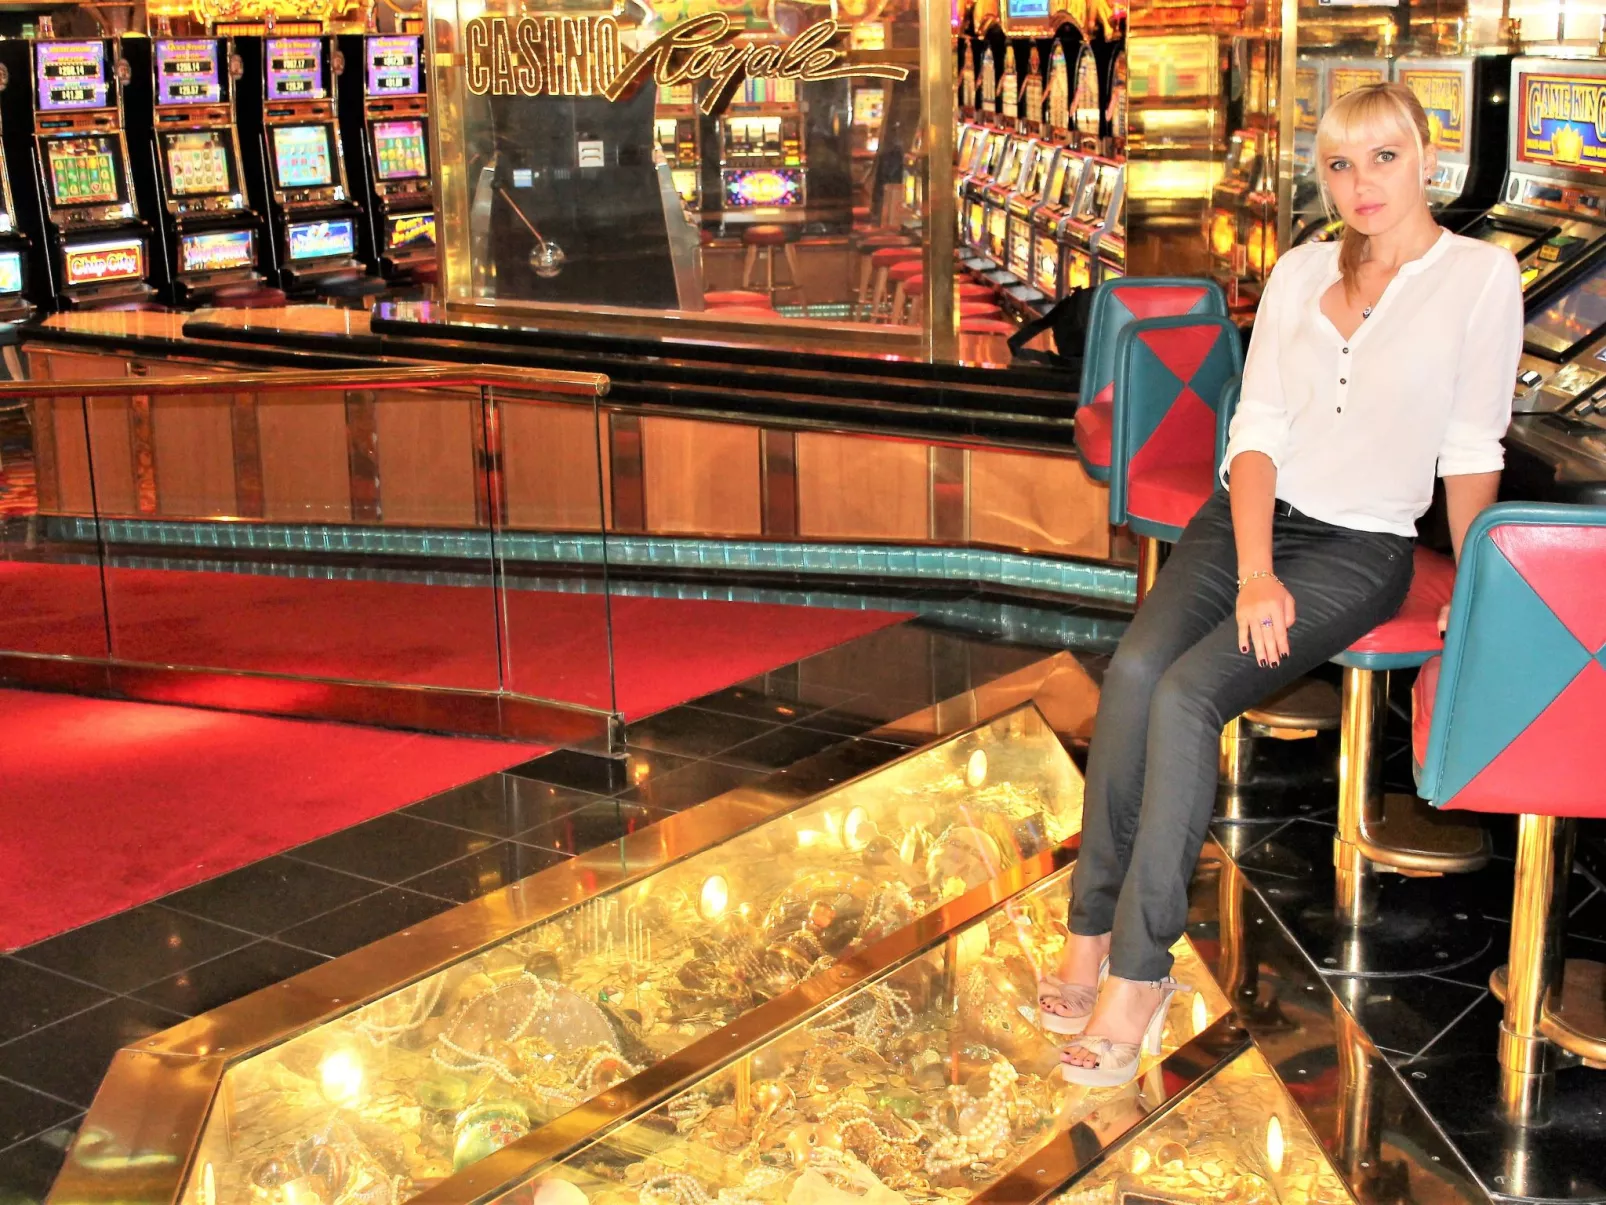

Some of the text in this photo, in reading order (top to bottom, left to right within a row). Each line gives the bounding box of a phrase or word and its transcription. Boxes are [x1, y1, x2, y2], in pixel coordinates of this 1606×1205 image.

[465, 11, 908, 116] CASINO Royale
[1528, 82, 1570, 135] GAME
[1572, 84, 1606, 143] KING
[71, 252, 136, 276] Chip City
